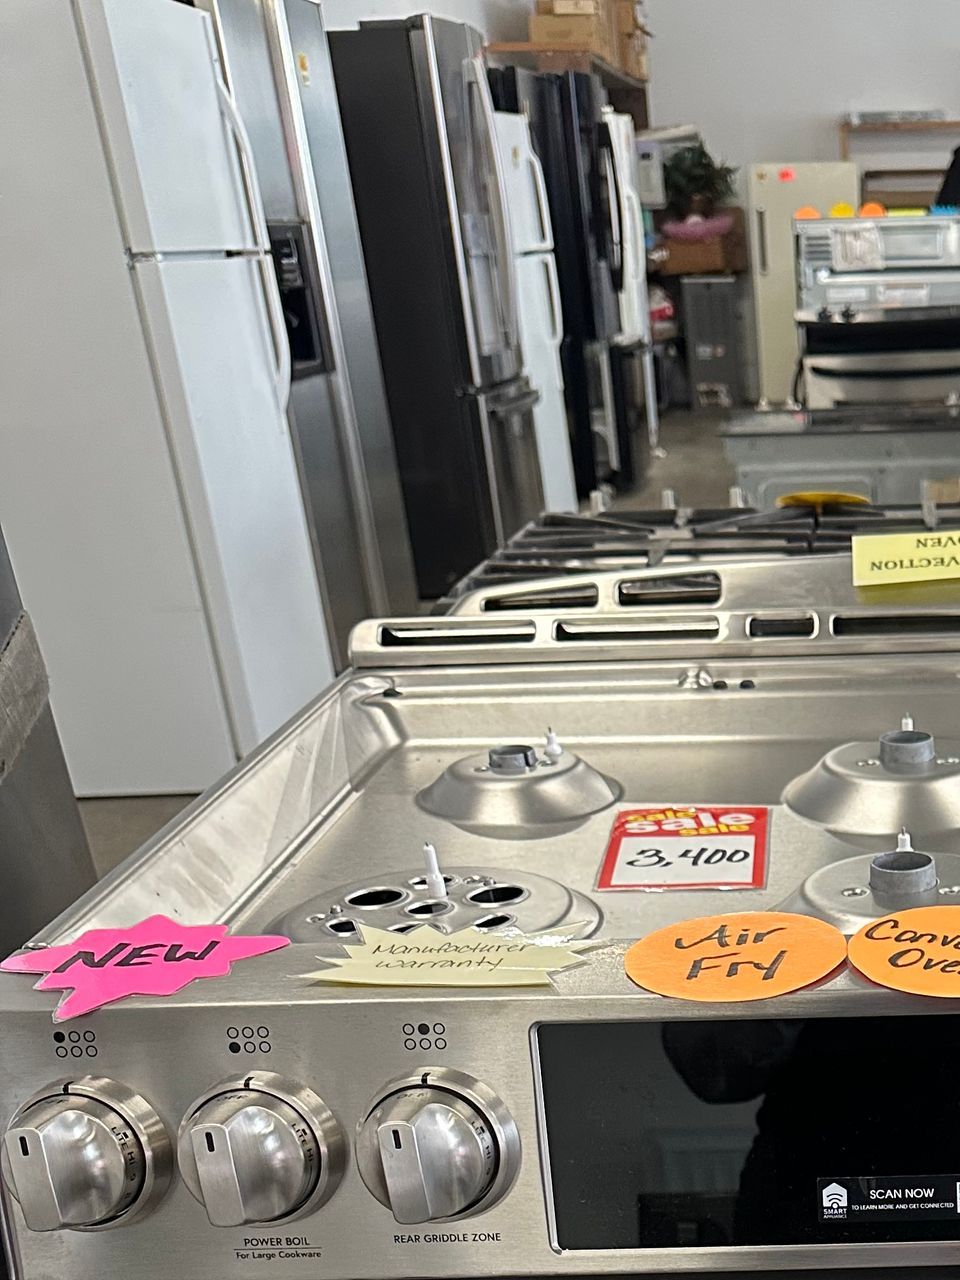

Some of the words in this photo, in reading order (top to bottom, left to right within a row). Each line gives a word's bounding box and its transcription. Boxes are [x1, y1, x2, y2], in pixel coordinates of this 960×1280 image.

[626, 809, 698, 822] sale
[624, 812, 756, 833] sale
[678, 824, 750, 837] sale
[626, 847, 751, 868] 3,400
[674, 924, 787, 949] Air
[372, 942, 538, 955] Manufacturer
[52, 941, 220, 973] NEW
[686, 950, 788, 980] Fry
[111, 1126, 129, 1150] LITE
[869, 1189, 902, 1200] SCAN
[905, 1188, 935, 1199] NOW
[244, 1238, 283, 1247] POWER
[285, 1237, 310, 1246] BOIL
[393, 1235, 420, 1243] REAR
[423, 1234, 468, 1243] GRIDDLE
[472, 1233, 502, 1242] ZONE
[236, 1252, 250, 1260] For
[252, 1252, 277, 1260] Large
[278, 1251, 321, 1259] Cookware
